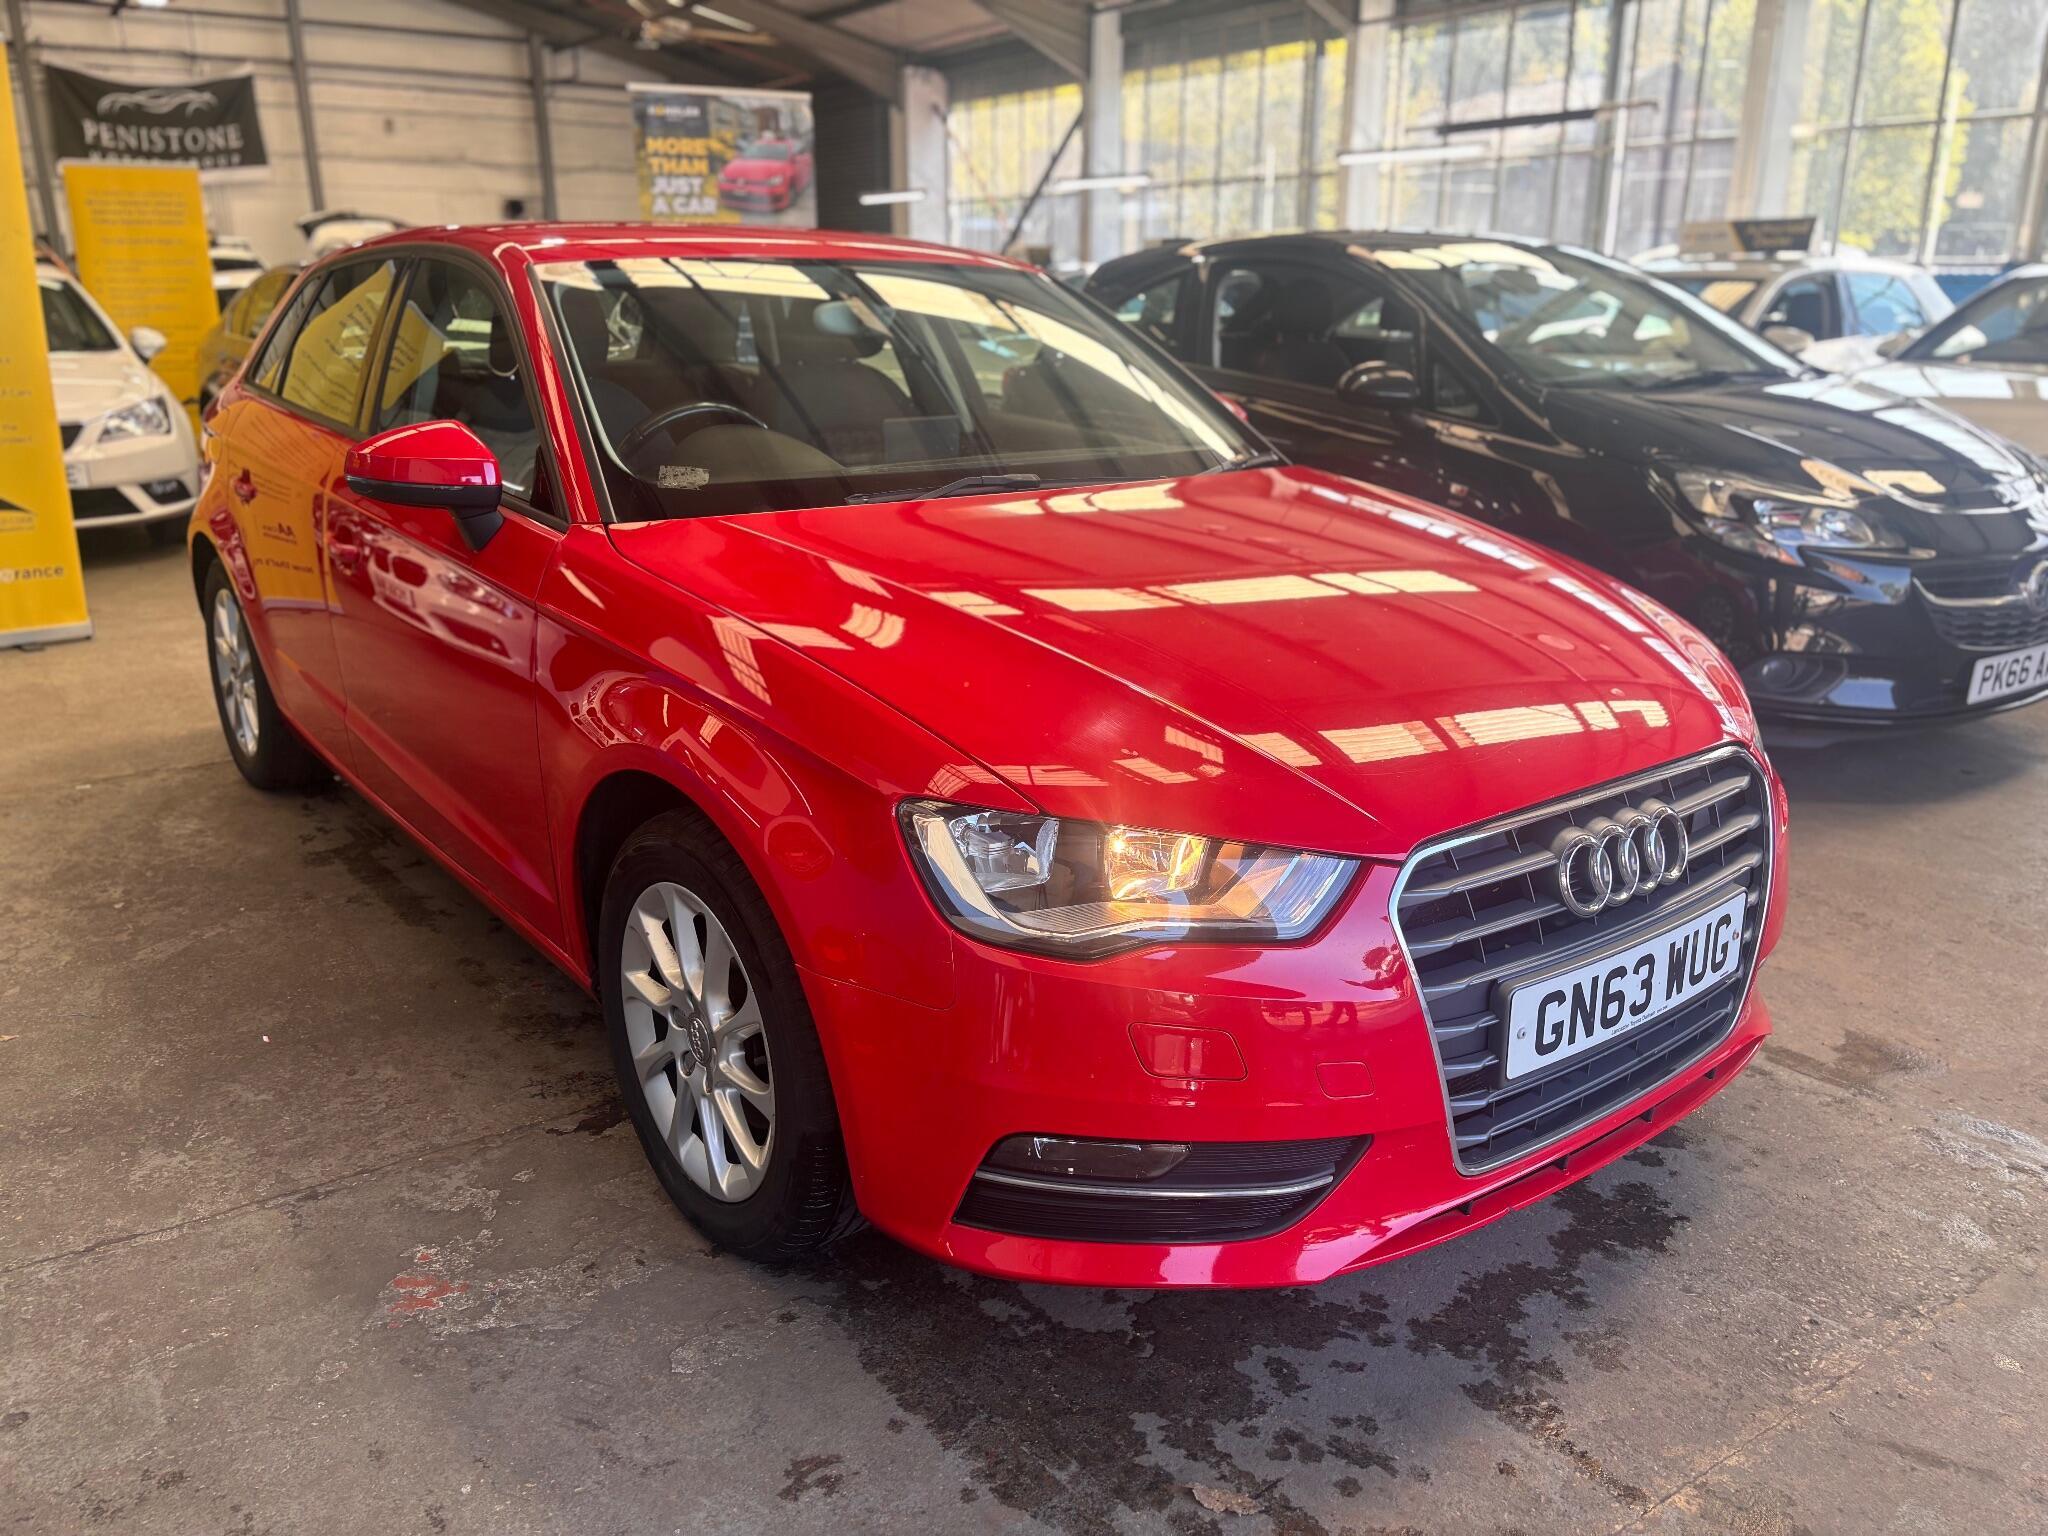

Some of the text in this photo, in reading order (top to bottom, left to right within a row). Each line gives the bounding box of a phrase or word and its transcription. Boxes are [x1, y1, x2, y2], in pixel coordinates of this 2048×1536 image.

[81, 118, 244, 153] PENISTONE
[648, 156, 709, 175] THAN
[651, 176, 703, 194] JUST
[652, 195, 718, 215] A CAR
[1978, 650, 2048, 695] PK66 A
[1534, 913, 1732, 1056] GN63 WUG
